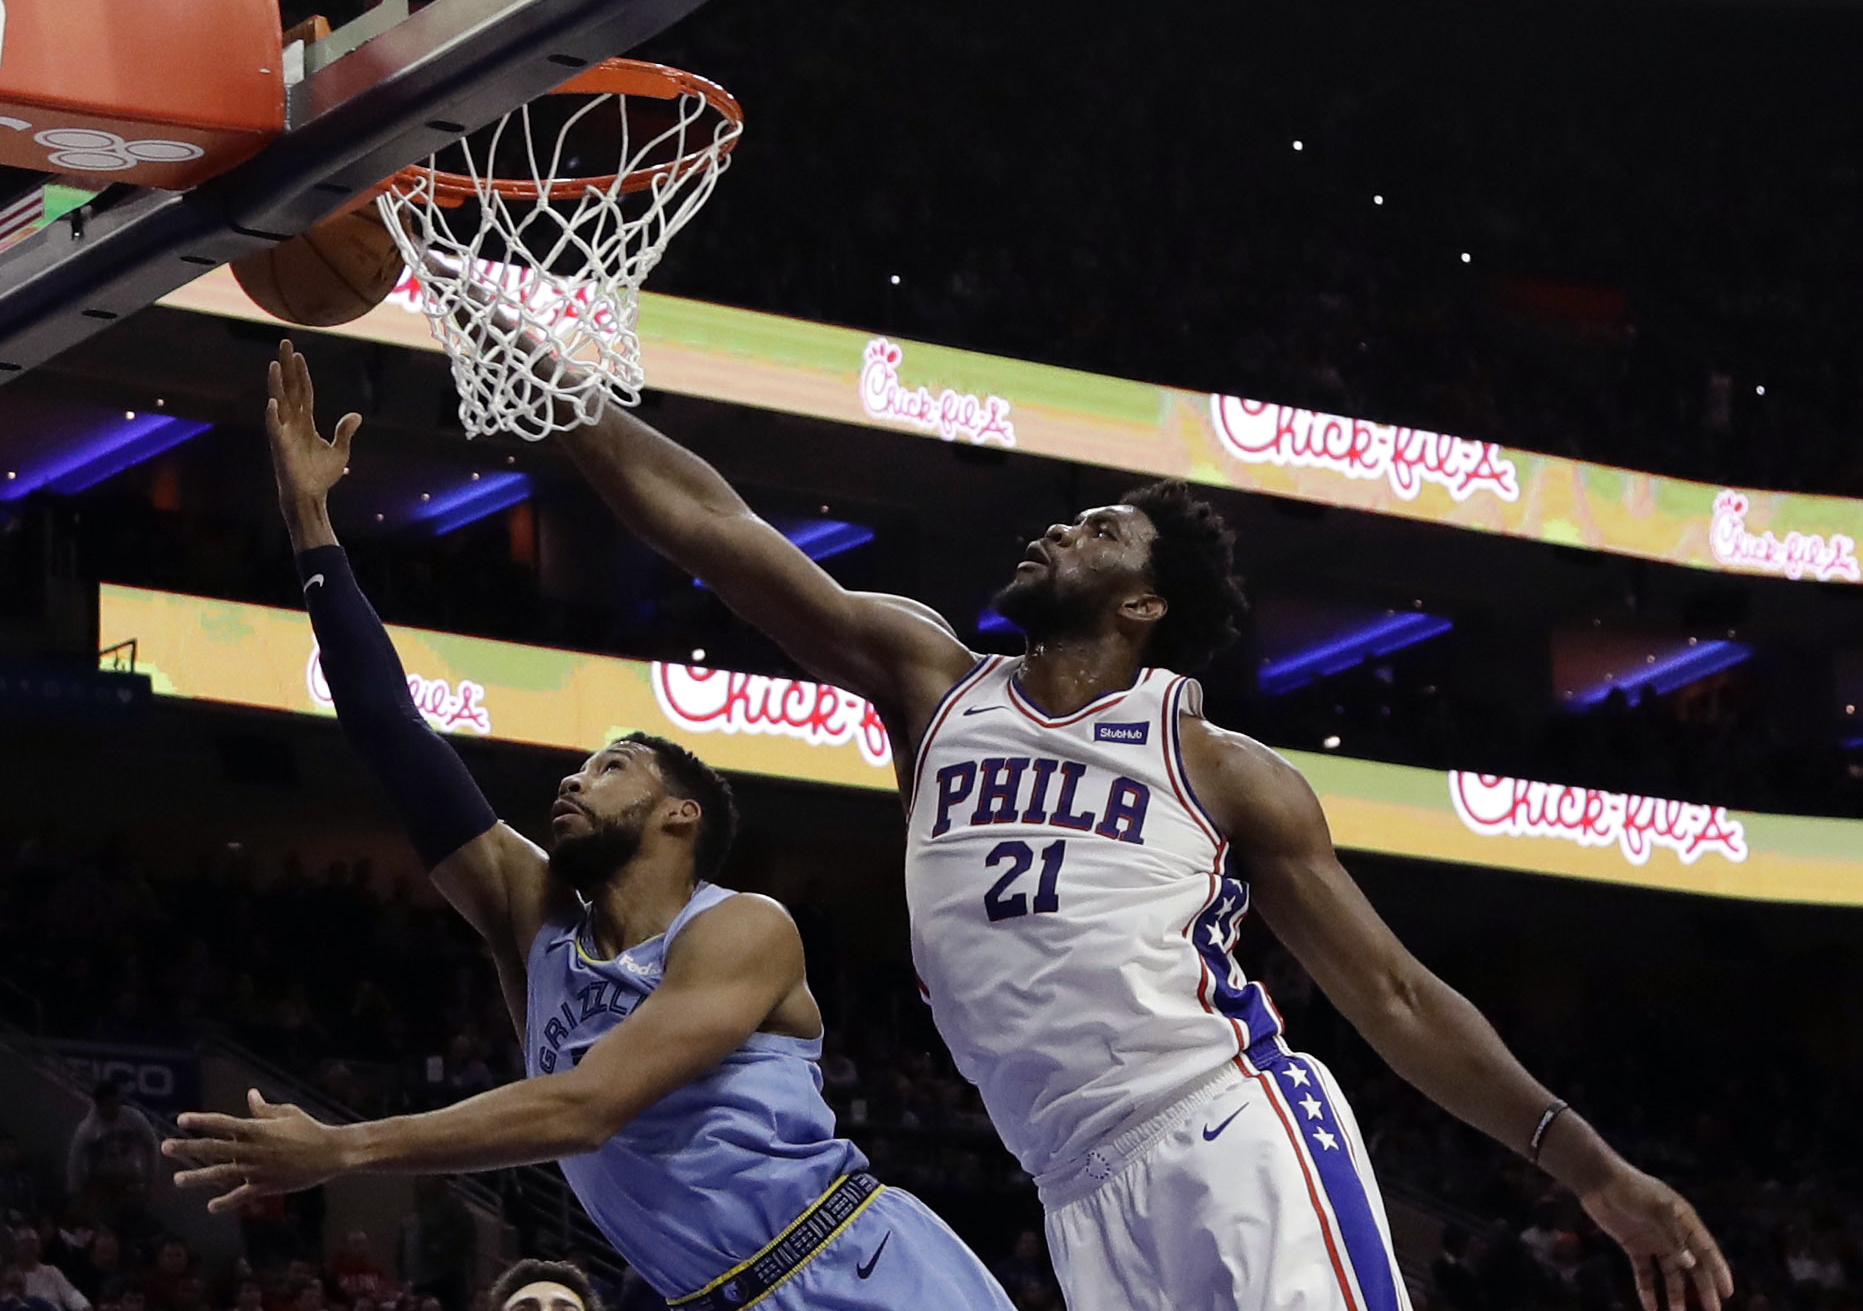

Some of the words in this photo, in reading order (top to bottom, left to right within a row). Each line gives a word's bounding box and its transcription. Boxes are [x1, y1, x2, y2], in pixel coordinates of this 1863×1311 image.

[861, 341, 1013, 442] Chick-fil-A
[1100, 727, 1143, 739] StubHub
[932, 758, 1150, 844] PHILA
[984, 840, 1065, 922] 21
